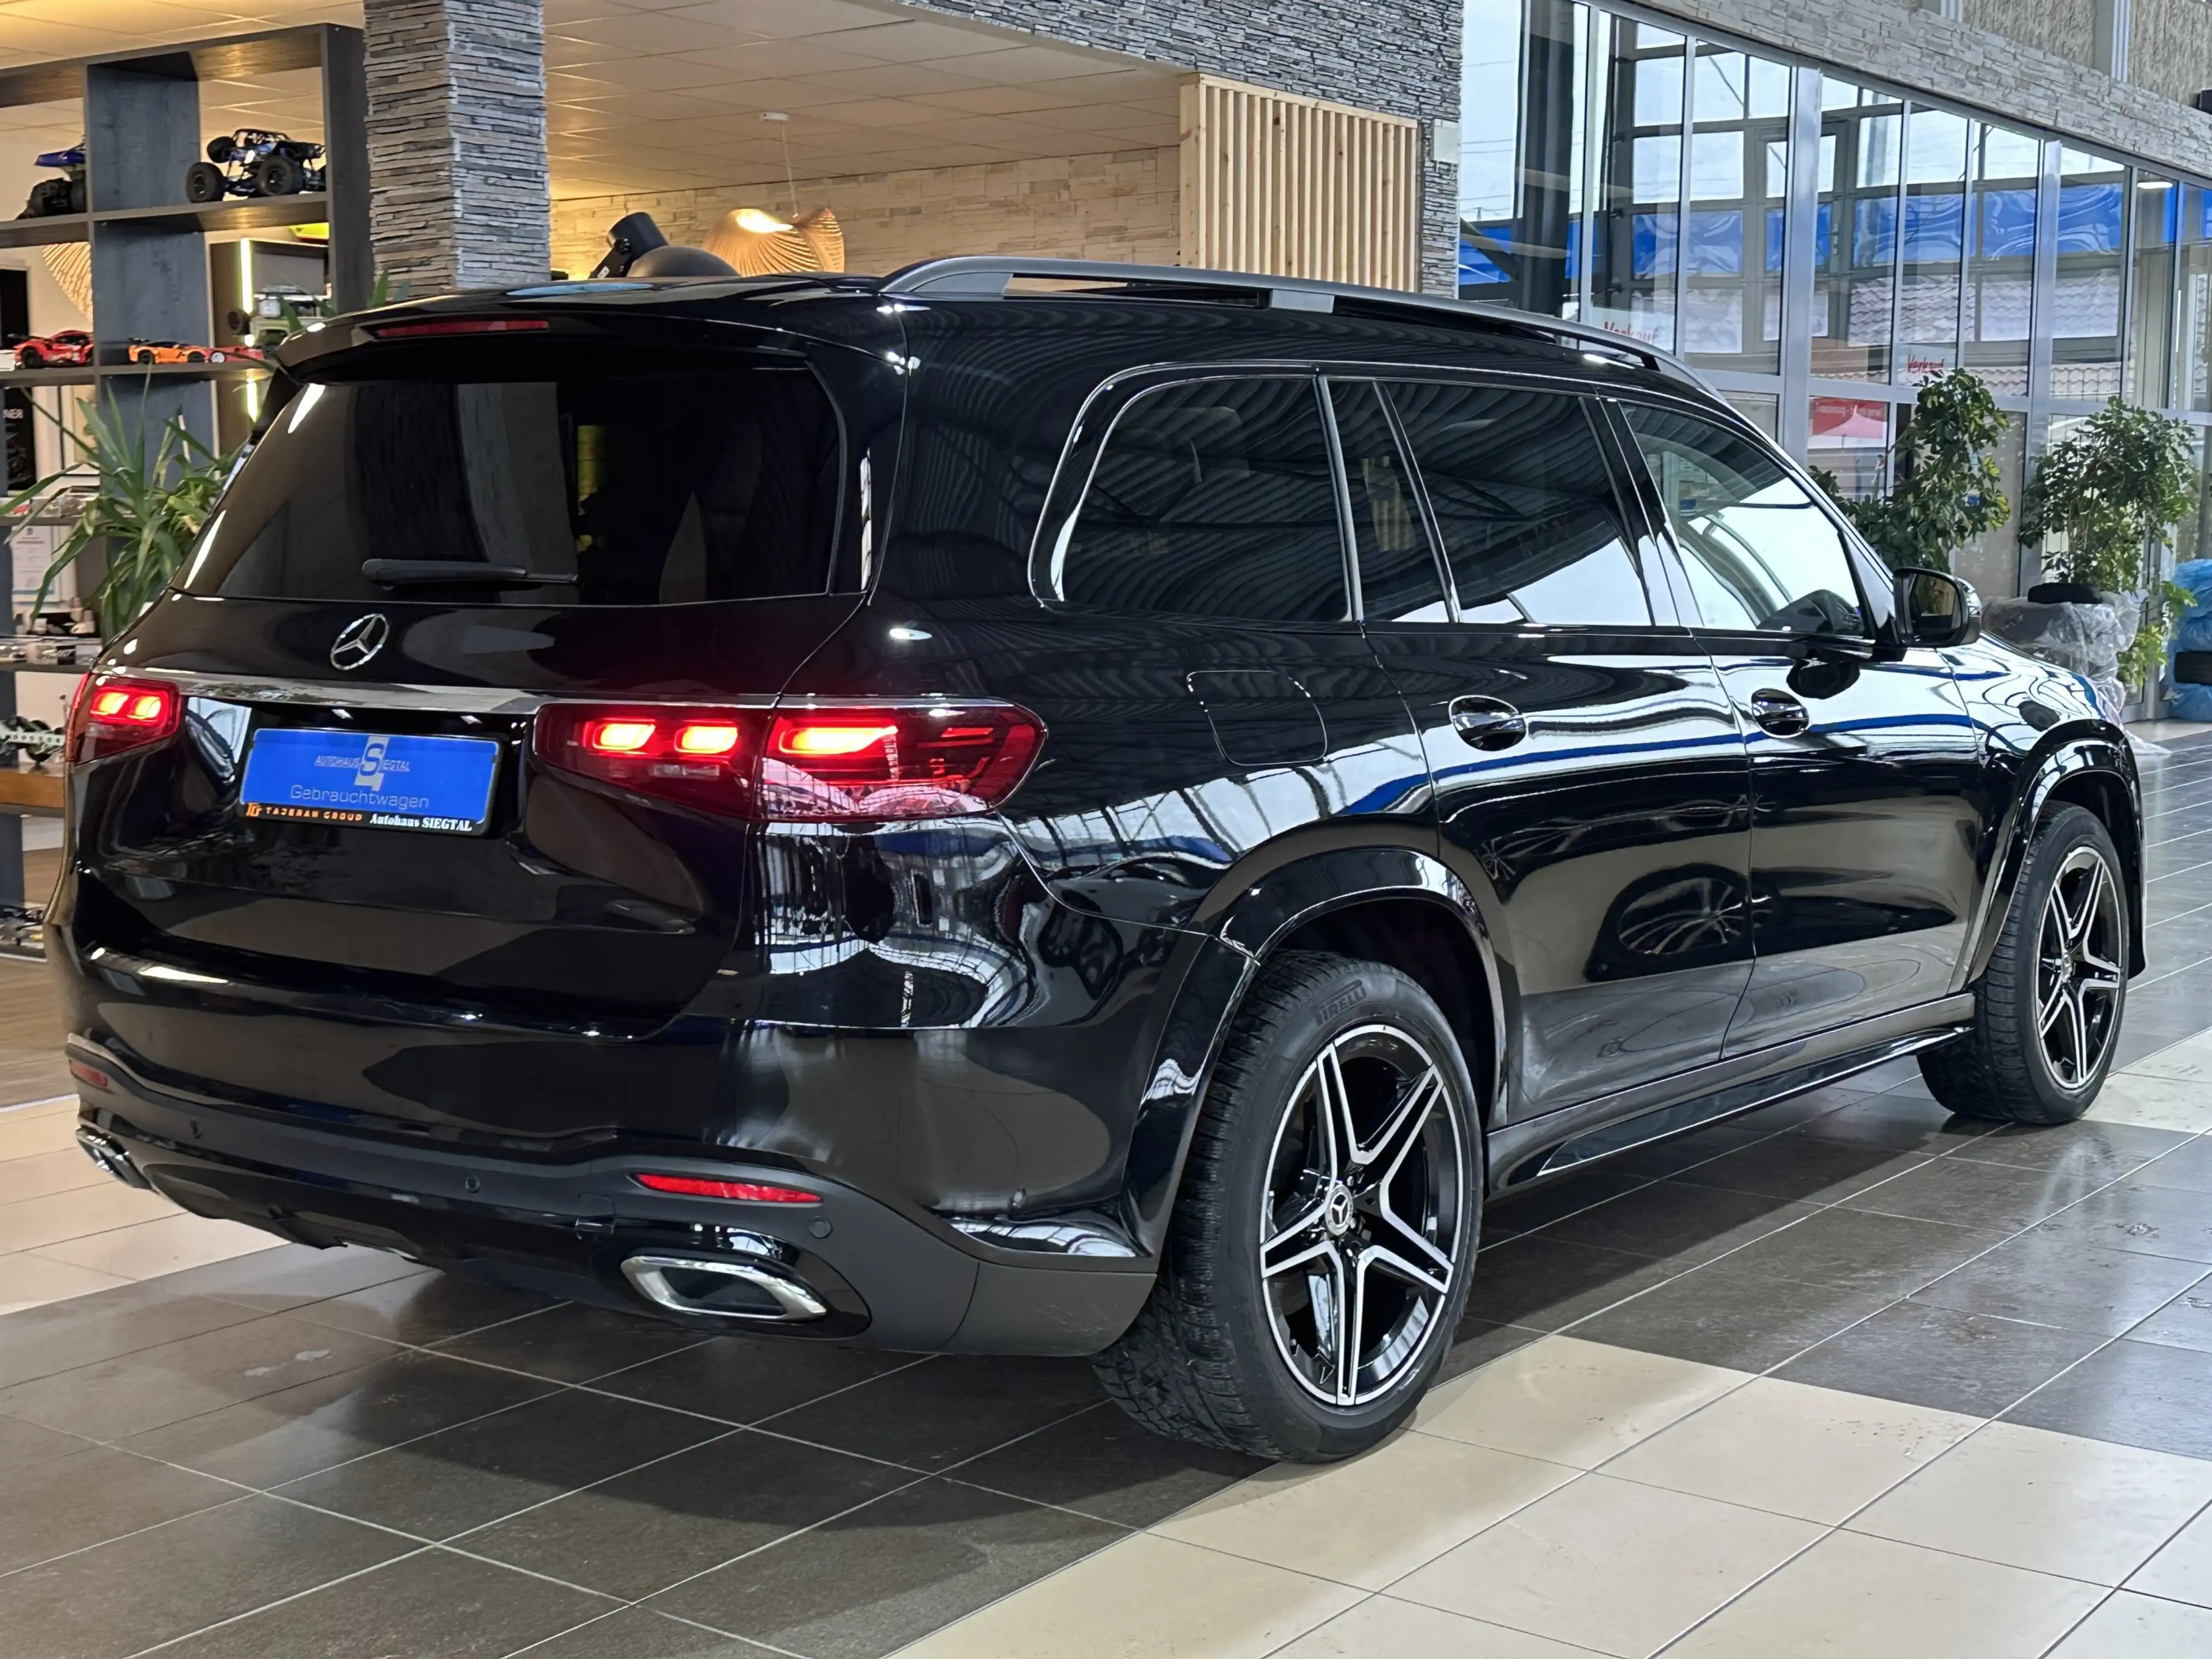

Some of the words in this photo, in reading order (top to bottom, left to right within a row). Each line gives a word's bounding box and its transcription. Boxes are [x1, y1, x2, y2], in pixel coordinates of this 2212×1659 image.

[290, 785, 429, 810] Gebrauchtwagen
[323, 811, 362, 821] GROUP
[369, 813, 420, 827] Autohaus
[422, 817, 472, 831] SIEGTAL
